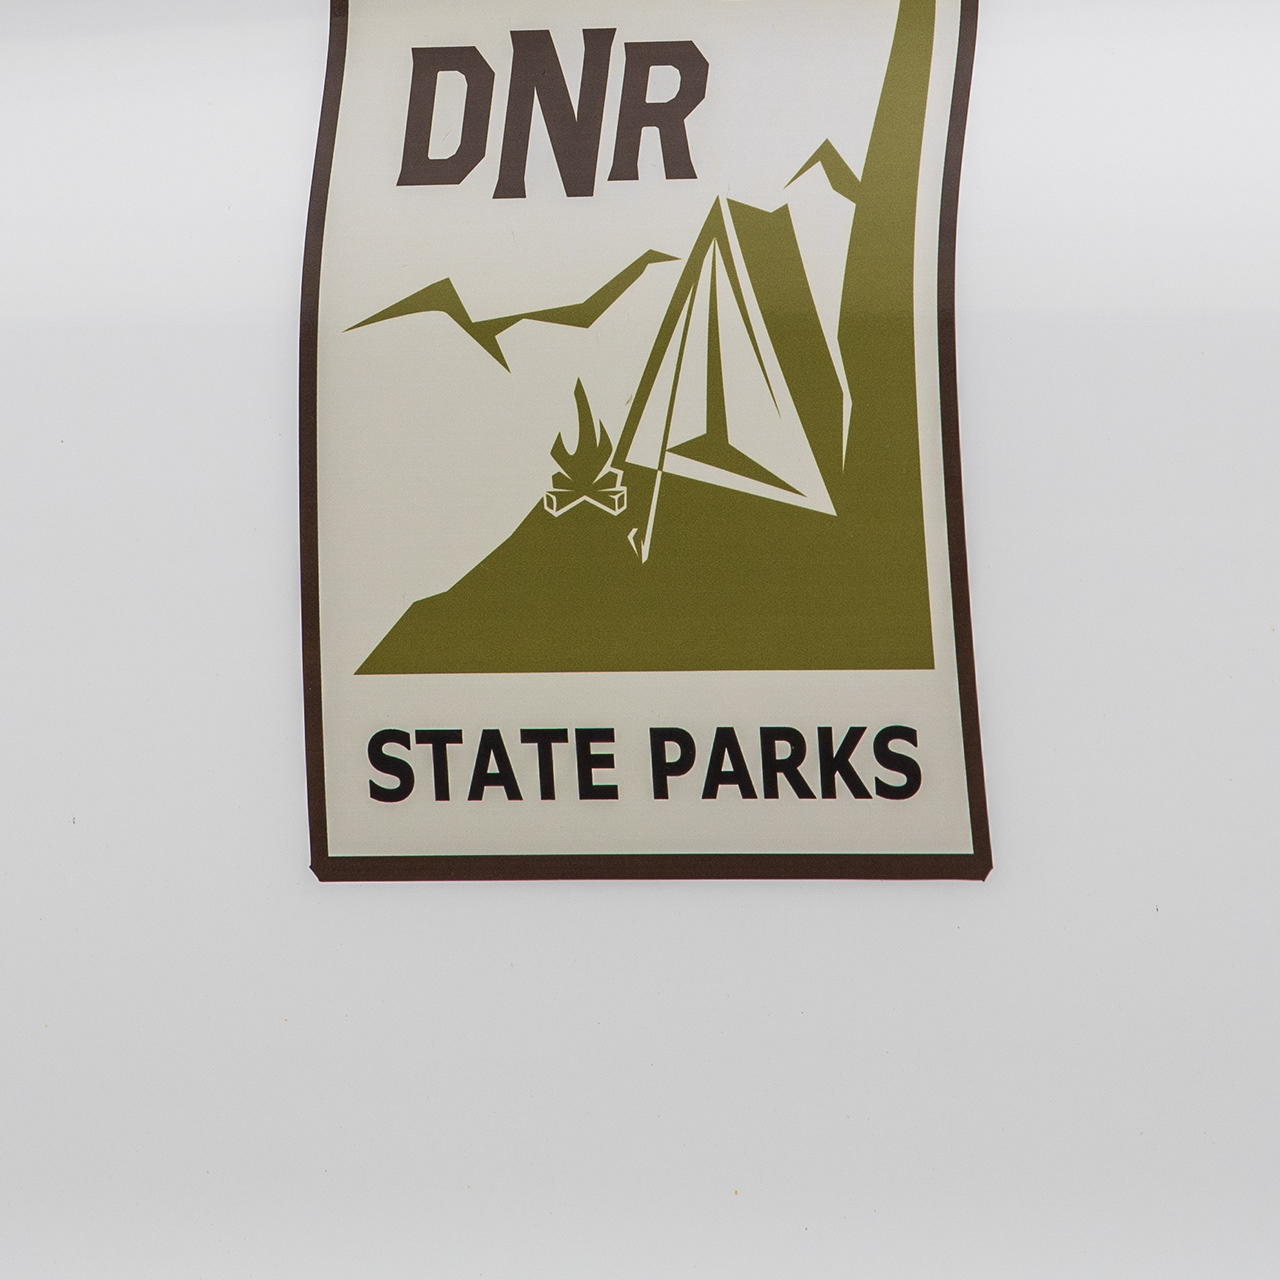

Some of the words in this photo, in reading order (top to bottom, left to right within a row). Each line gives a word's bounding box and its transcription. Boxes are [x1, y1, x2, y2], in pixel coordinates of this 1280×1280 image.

[396, 28, 710, 200] DNR
[367, 728, 619, 802] STATE
[650, 725, 922, 800] PARKS
